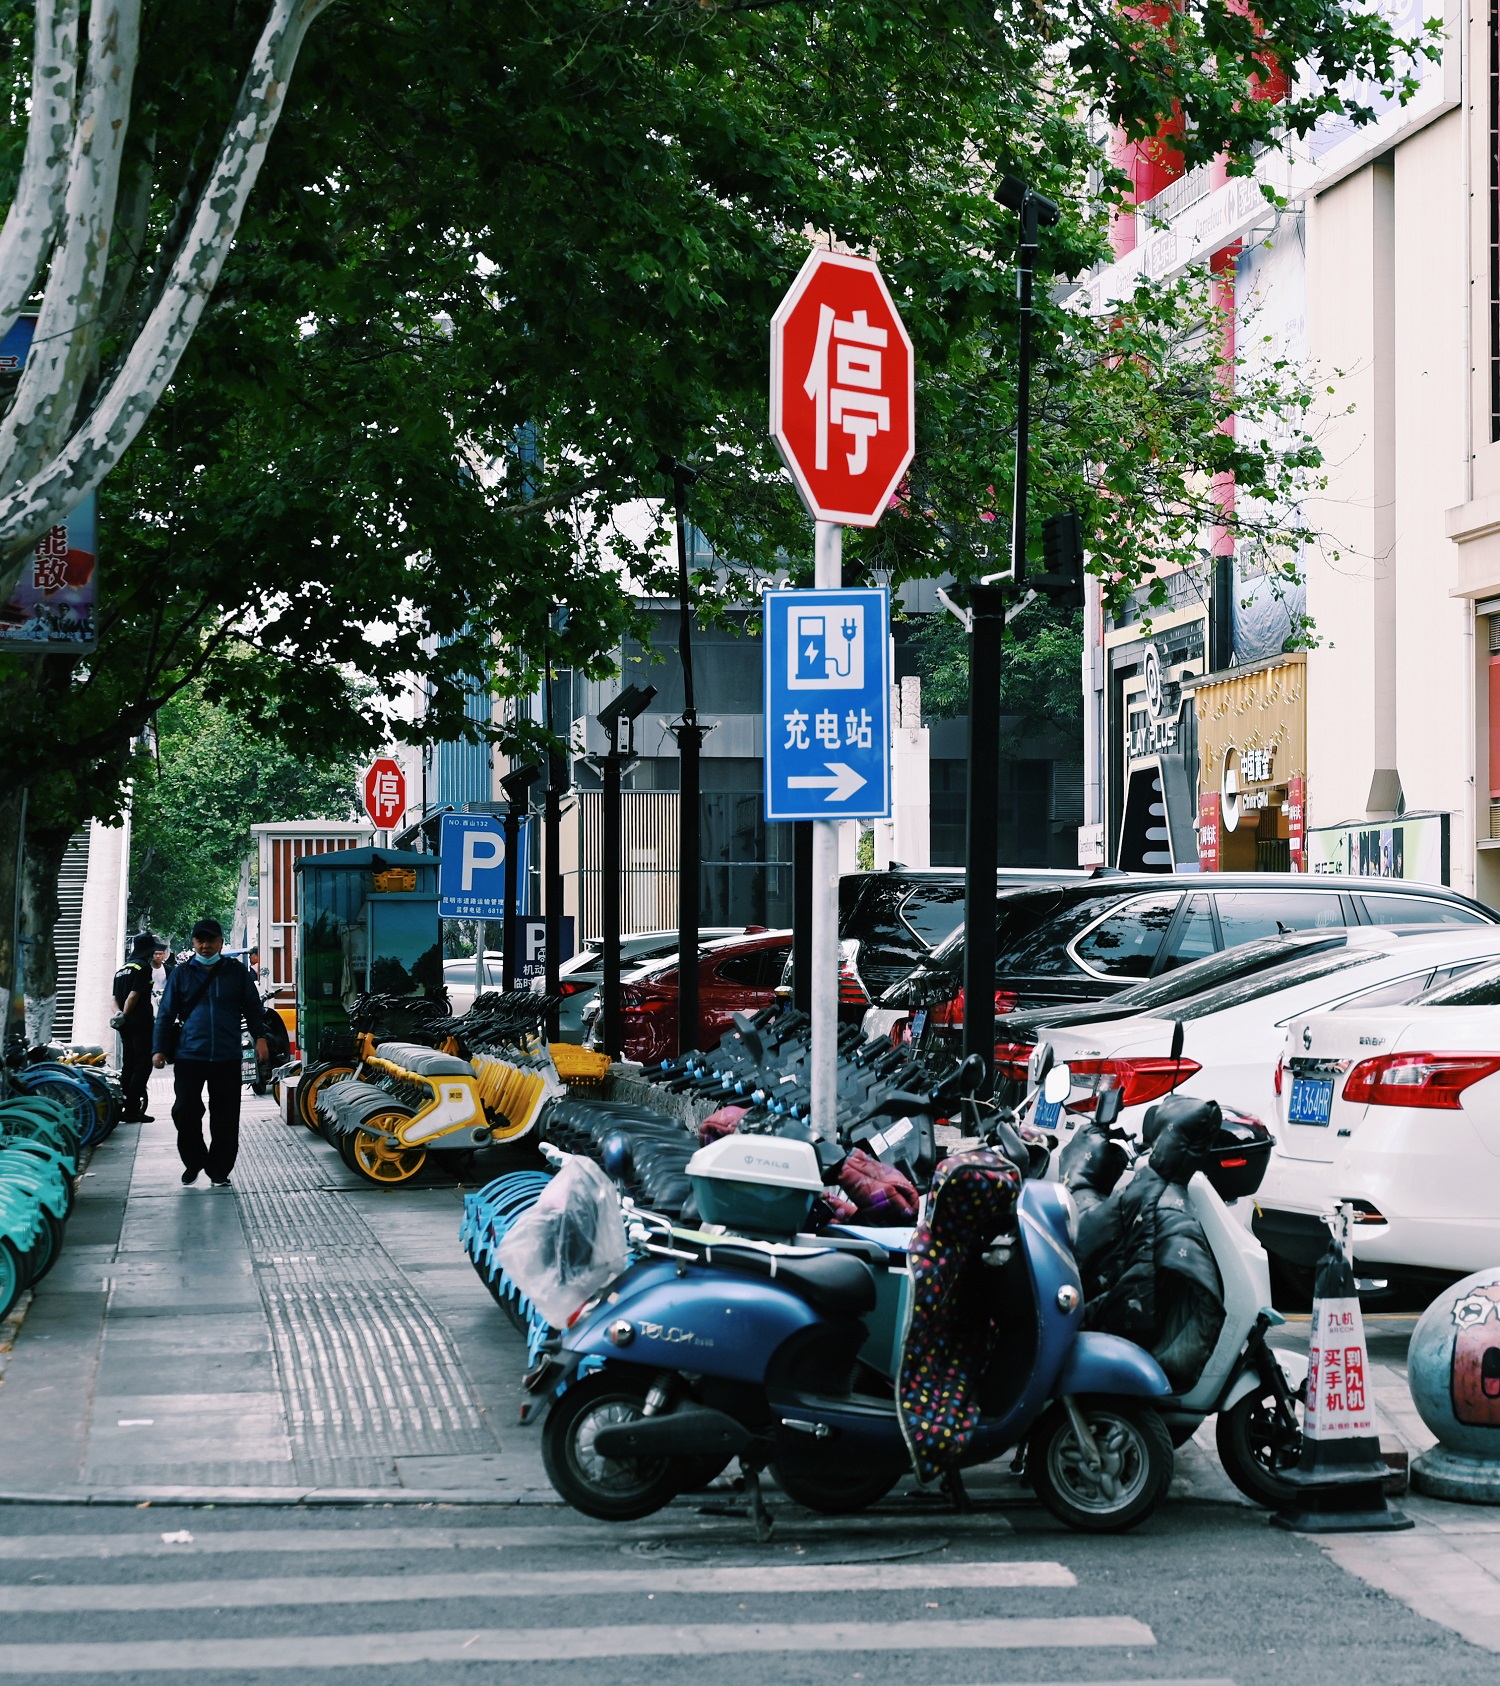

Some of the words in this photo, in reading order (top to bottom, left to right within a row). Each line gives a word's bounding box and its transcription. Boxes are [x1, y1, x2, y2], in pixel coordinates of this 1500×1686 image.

[803, 302, 891, 476] 停
[783, 708, 873, 751] 充电站
[1126, 727, 1147, 755] PLAY
[1149, 722, 1176, 750] PLUS
[372, 770, 400, 818] 停
[461, 831, 506, 891] P
[1328, 1312, 1354, 1327] 九机
[1324, 1349, 1344, 1411] 买手机
[1346, 1350, 1364, 1408] 到九机
